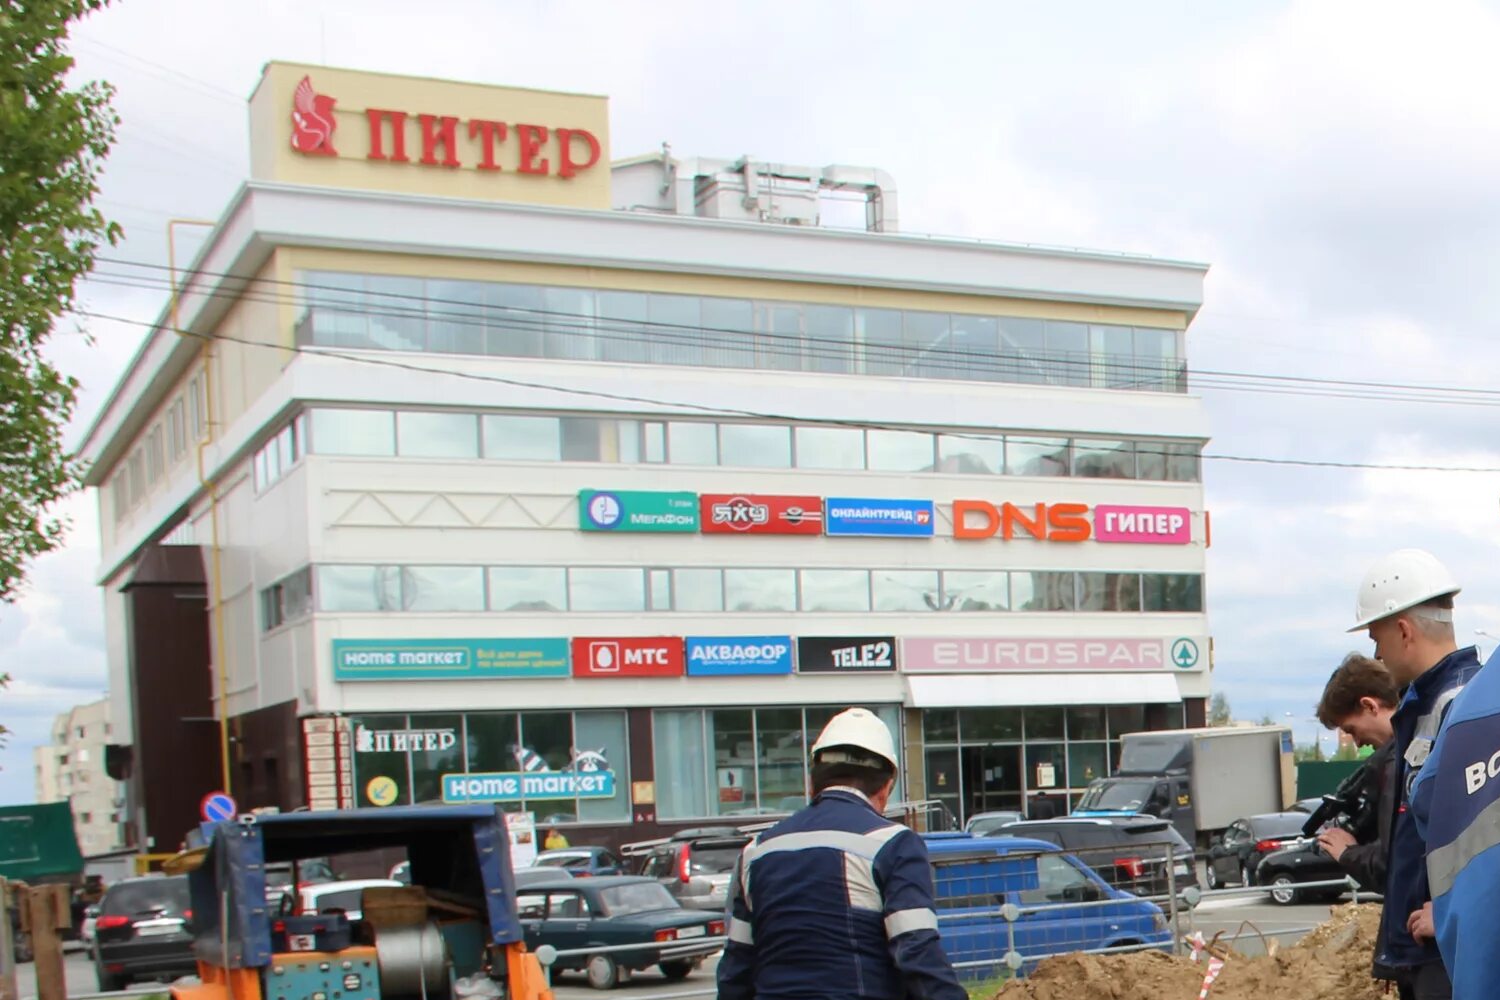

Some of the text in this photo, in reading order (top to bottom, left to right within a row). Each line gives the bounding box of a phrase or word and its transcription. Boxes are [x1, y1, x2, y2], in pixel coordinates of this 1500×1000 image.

[365, 108, 601, 179] ПИТЕР
[831, 507, 913, 521] ОНЛАЙНТРЕЙД
[953, 500, 1092, 541] DNS
[1105, 512, 1184, 535] ГИПЕР
[624, 648, 669, 665] МТС
[691, 644, 787, 660] АКВАФОР
[832, 641, 892, 668] TELE2
[932, 642, 1162, 665] EUROSPAR
[374, 730, 456, 752] ПИТЕР
